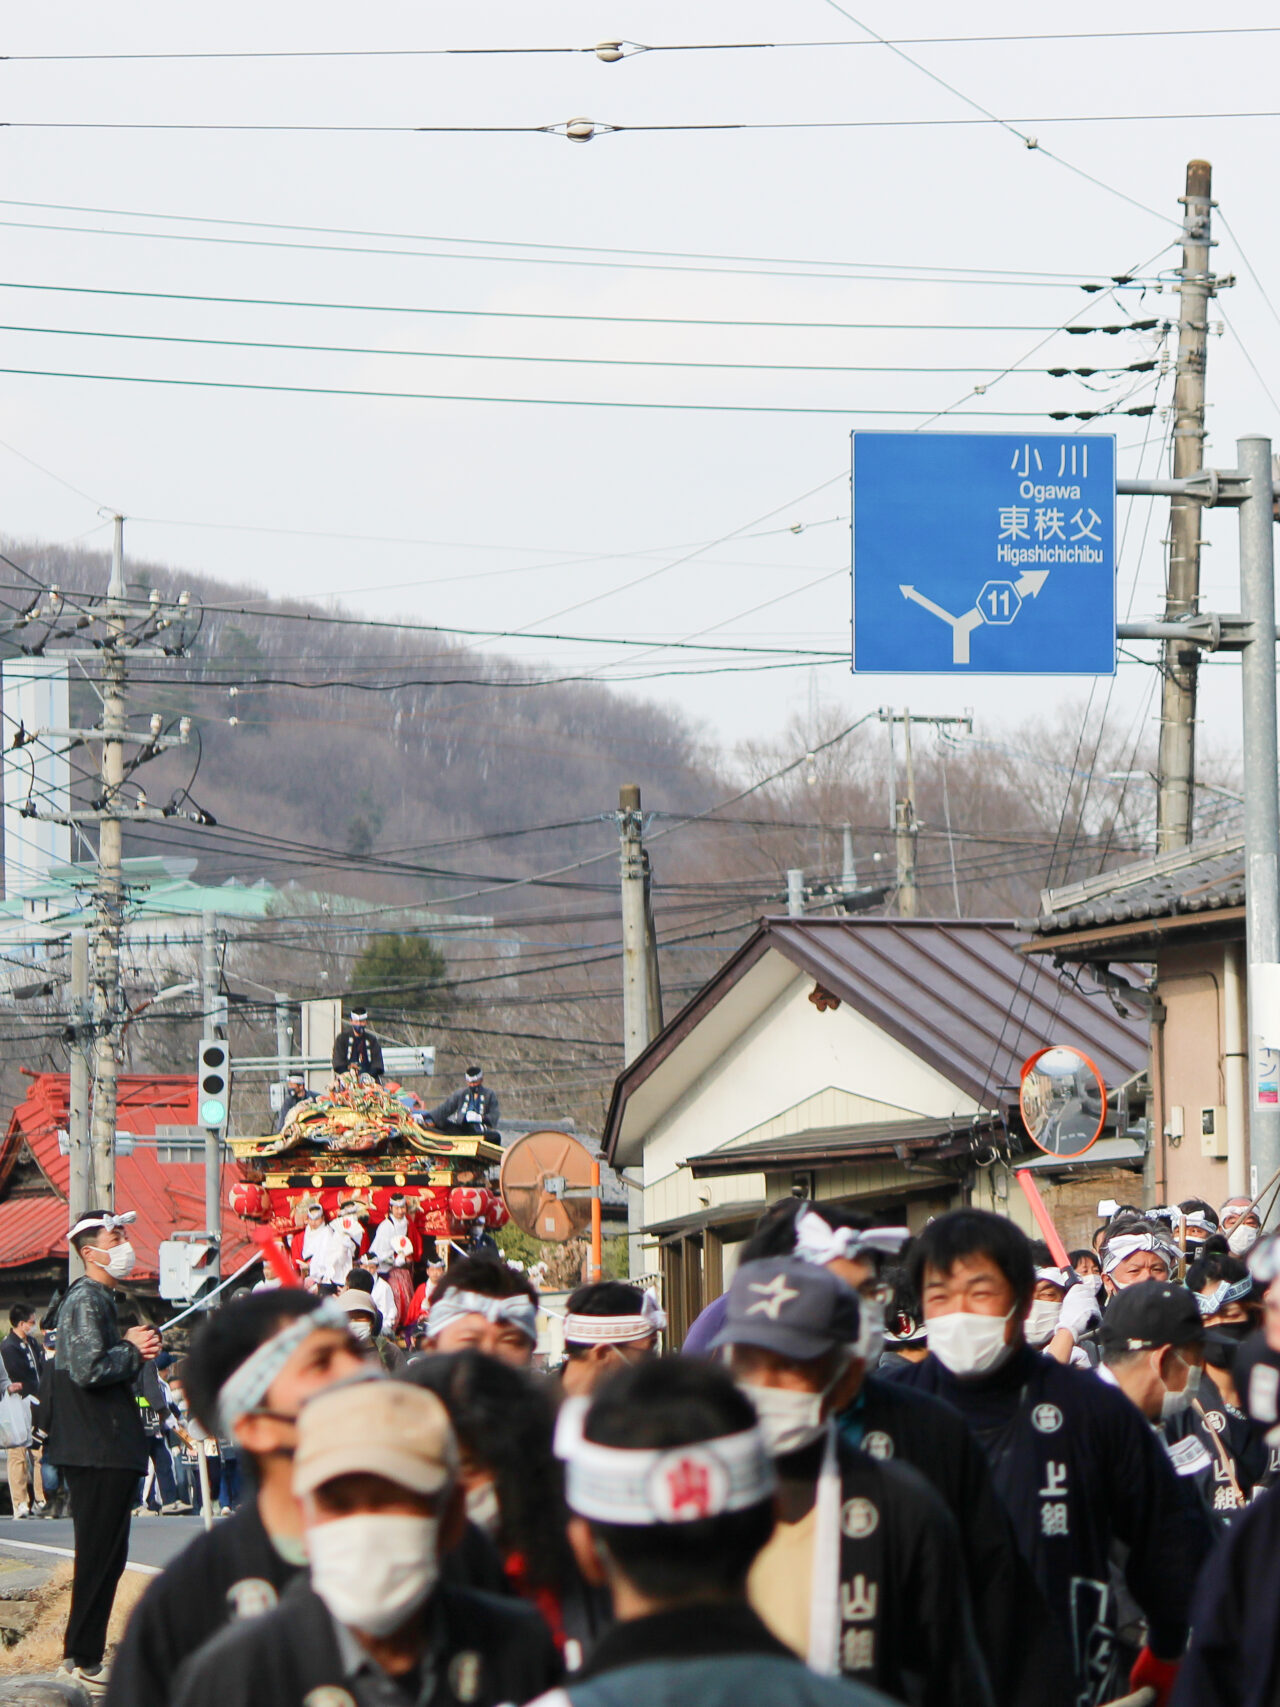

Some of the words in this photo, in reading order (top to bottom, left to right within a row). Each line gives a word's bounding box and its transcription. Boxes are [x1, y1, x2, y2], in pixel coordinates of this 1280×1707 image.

[1010, 443, 1087, 478] 小川
[1020, 481, 1080, 503] Ogawa
[998, 505, 1102, 541] 東秩父
[997, 544, 1103, 566] Higashichichibu
[987, 590, 1010, 616] 11
